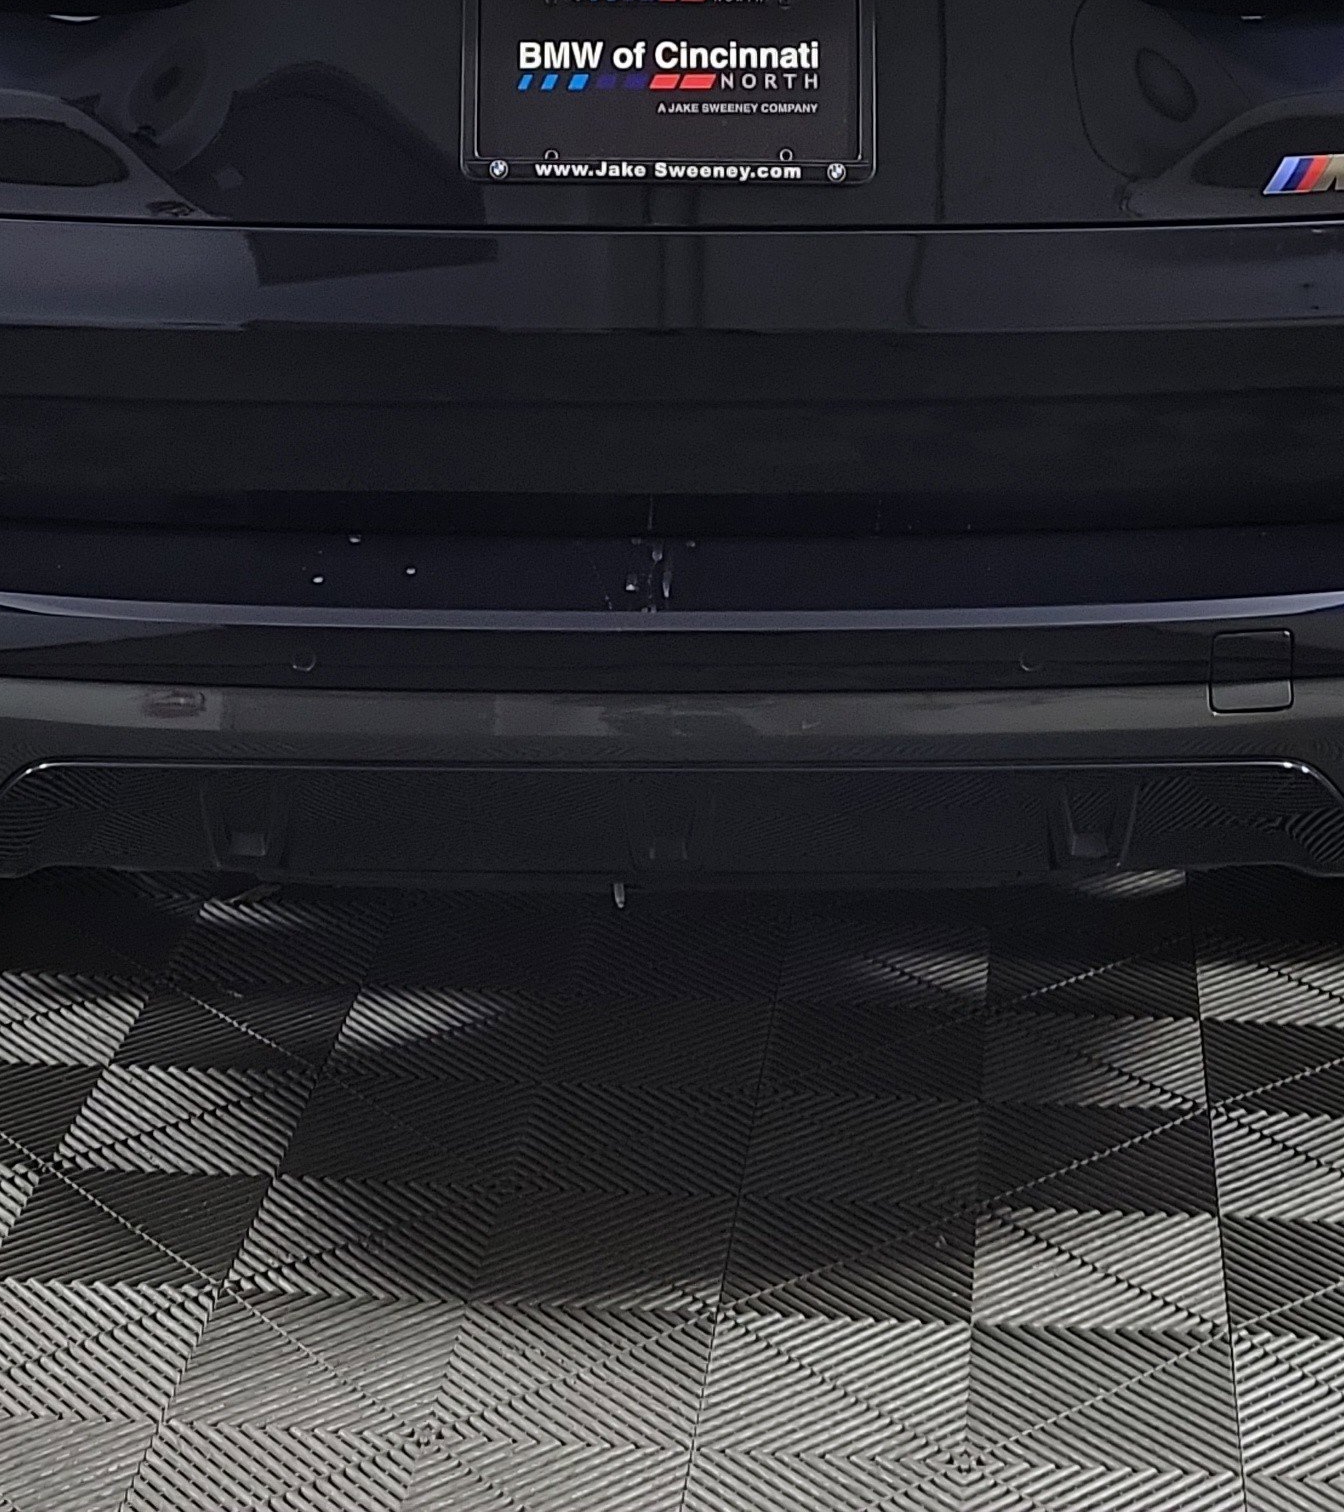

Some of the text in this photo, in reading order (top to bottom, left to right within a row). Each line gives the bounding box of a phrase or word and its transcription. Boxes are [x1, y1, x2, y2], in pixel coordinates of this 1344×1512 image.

[518, 40, 819, 70] BMW of Cincinnati
[720, 73, 819, 90] NORTH
[657, 103, 818, 114] A JAKE SWEENEY COMPANY
[534, 161, 802, 182] www.Jake Sweeney.com
